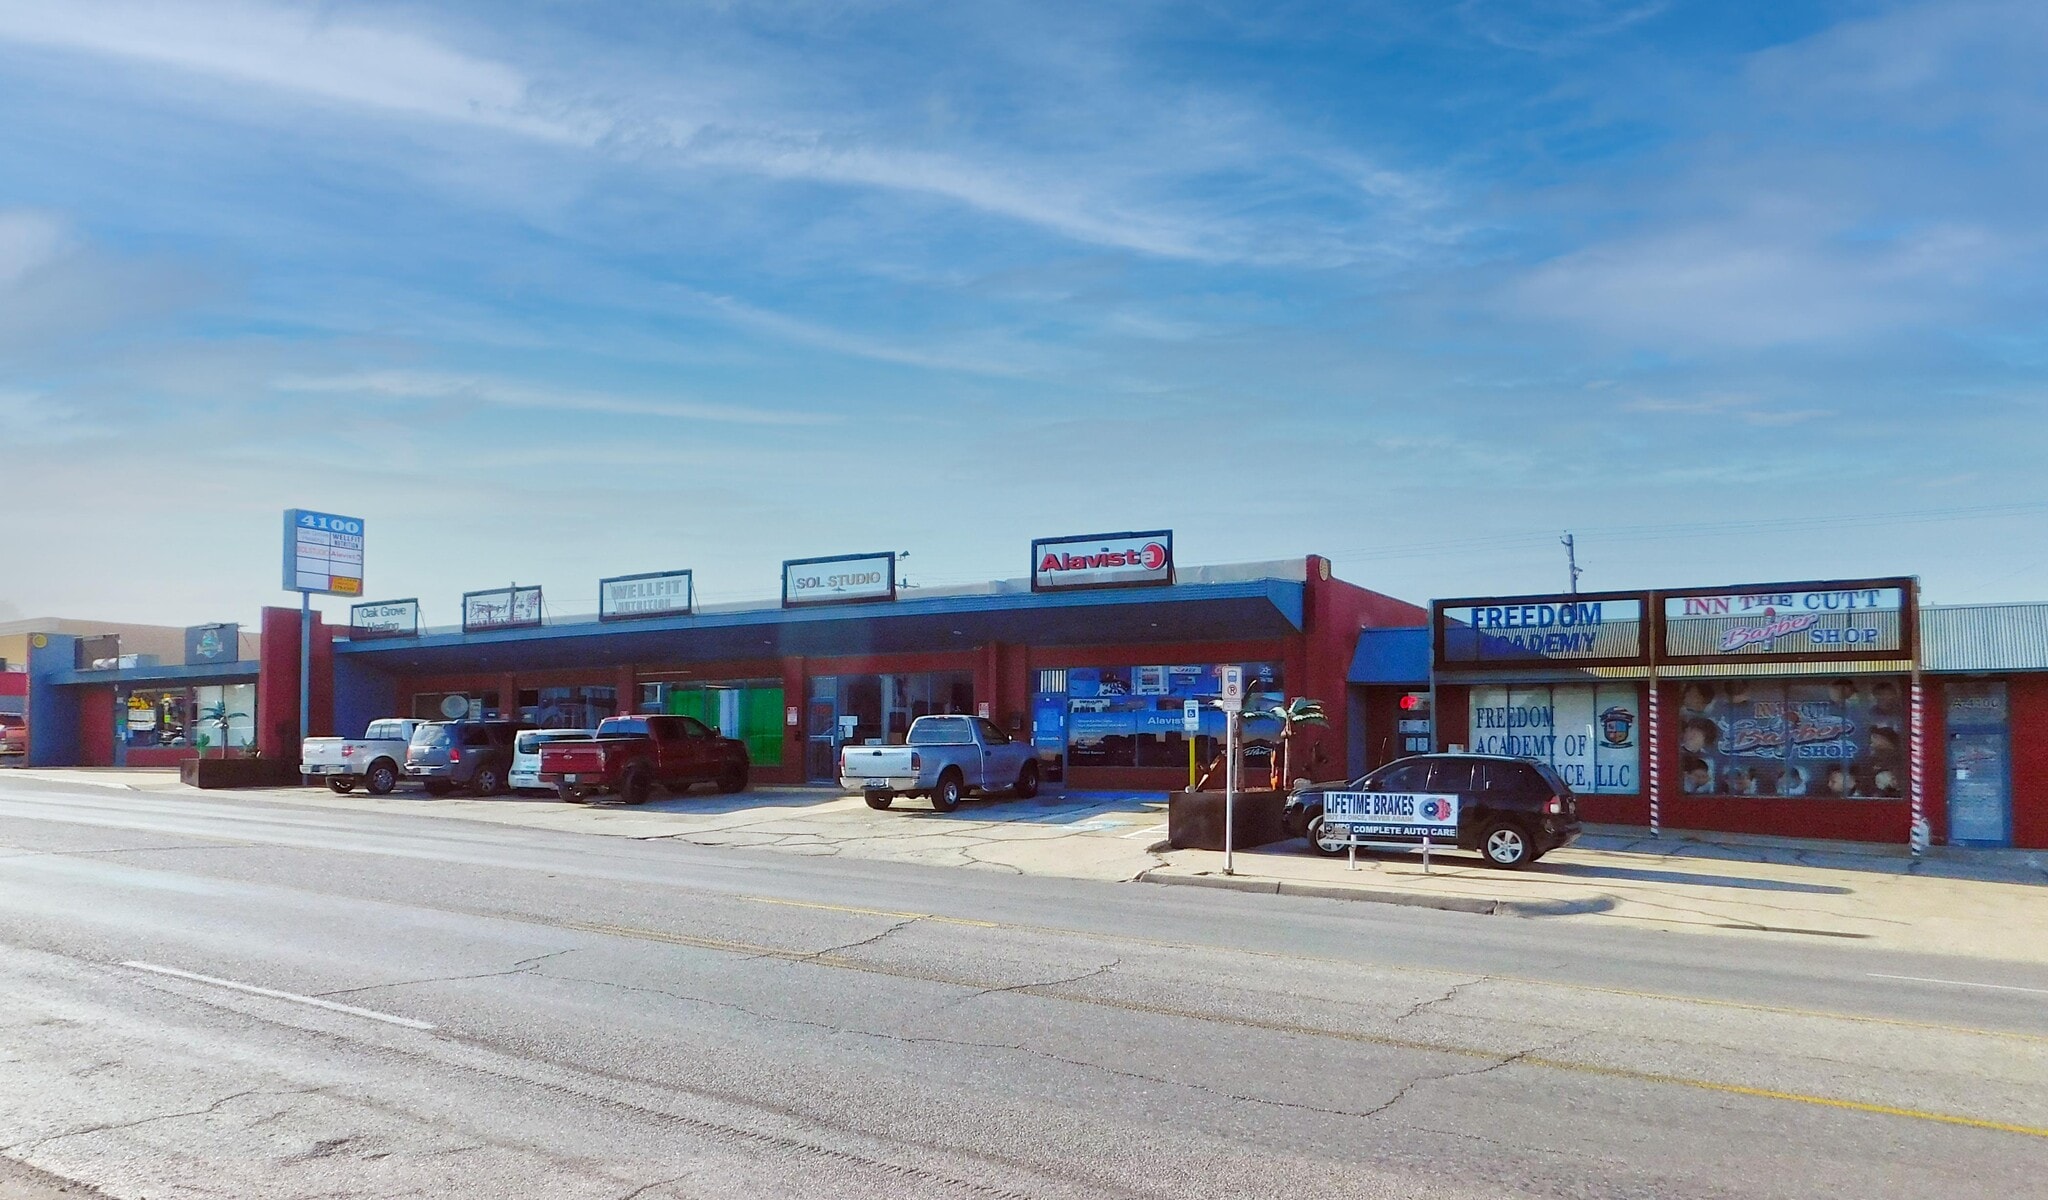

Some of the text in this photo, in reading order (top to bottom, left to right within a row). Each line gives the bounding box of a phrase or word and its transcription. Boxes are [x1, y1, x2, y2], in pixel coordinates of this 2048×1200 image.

[301, 515, 359, 533] 4100
[1038, 542, 1167, 572] Alavista
[610, 580, 682, 599] WELLFIT
[796, 572, 881, 589] SOL STUDIO
[361, 607, 407, 618] Oak Grove
[617, 598, 671, 613] NUTRITION
[1683, 590, 1880, 616] INN THE CUTT
[1471, 603, 1603, 628] FREEDOM
[1718, 613, 1819, 652] Barber
[1811, 628, 1879, 644] SHOP
[1147, 716, 1184, 725] Alavist
[1476, 706, 1555, 728] FREEDOM
[1475, 735, 1587, 757] ACADEMY OF
[1596, 765, 1630, 787] LLC
[1326, 794, 1414, 815] LIFETIME BRAKES
[1353, 825, 1401, 835] COMPLETE
[1403, 827, 1428, 836] AUTO
[1430, 828, 1456, 836] CARE
